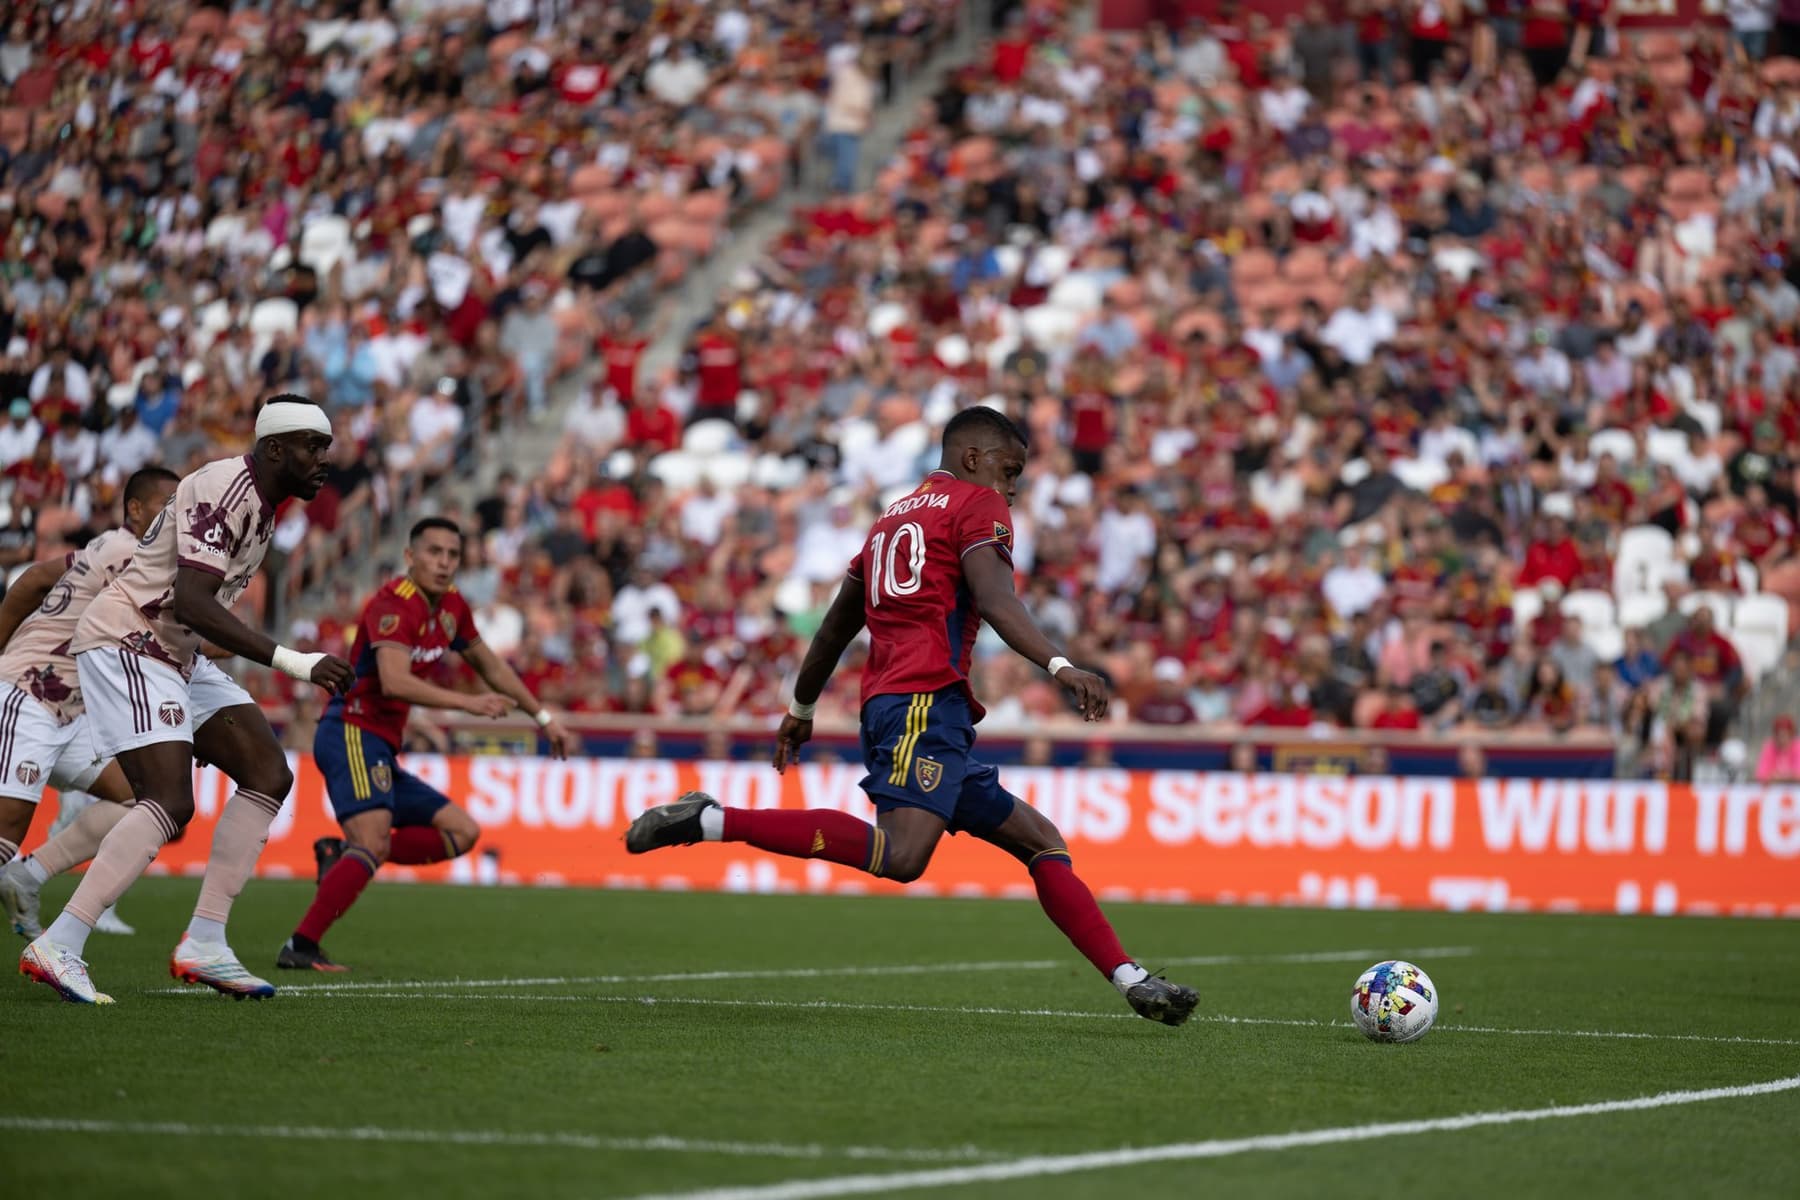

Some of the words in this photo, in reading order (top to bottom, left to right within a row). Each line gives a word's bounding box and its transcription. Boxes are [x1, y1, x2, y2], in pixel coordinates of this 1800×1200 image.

[878, 493, 950, 522] ORDOVA
[196, 541, 226, 559] TikTok
[871, 521, 927, 608] 10
[466, 756, 678, 829] store
[1147, 770, 1456, 850] season
